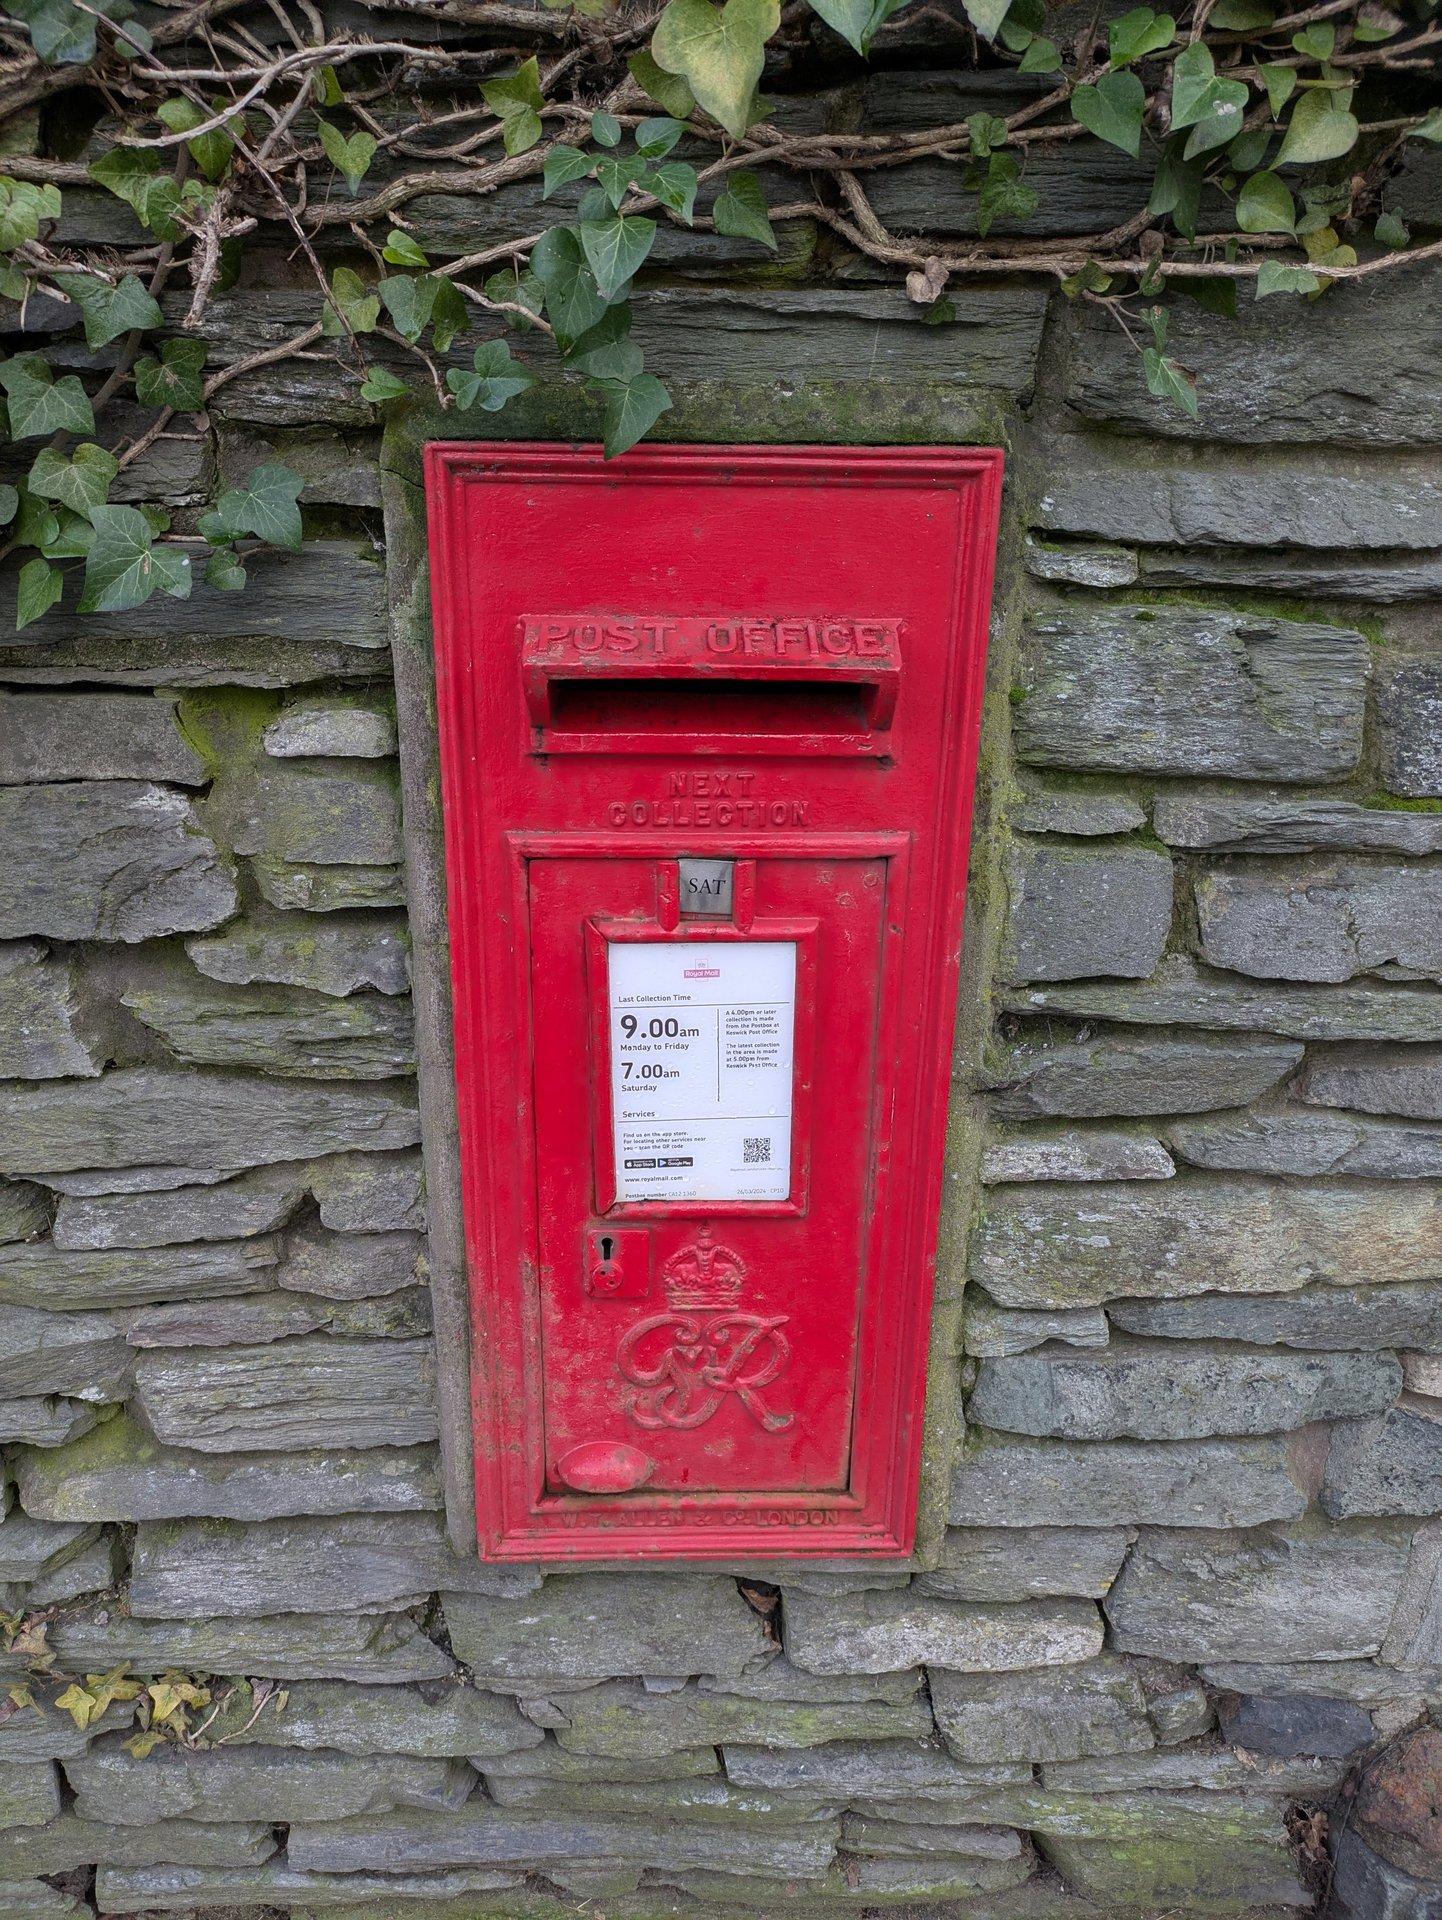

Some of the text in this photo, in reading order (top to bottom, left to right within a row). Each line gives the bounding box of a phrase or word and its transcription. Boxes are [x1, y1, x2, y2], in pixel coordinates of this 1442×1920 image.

[537, 621, 893, 658] POST OFFICE
[668, 771, 756, 798] NEXT
[607, 800, 811, 829] COLLECTION
[688, 877, 727, 896] SAT
[685, 969, 719, 978] Royal Mail
[636, 994, 672, 1002] Collection
[620, 1014, 700, 1039] 9.00am
[620, 1043, 652, 1052] Monday
[664, 1042, 690, 1051] Friday
[620, 1062, 680, 1080] 7.00am
[621, 1084, 658, 1092] Saturday
[622, 1110, 656, 1118] Services
[624, 1175, 684, 1183] www.royalmail.com
[755, 1509, 840, 1527] LONDON
